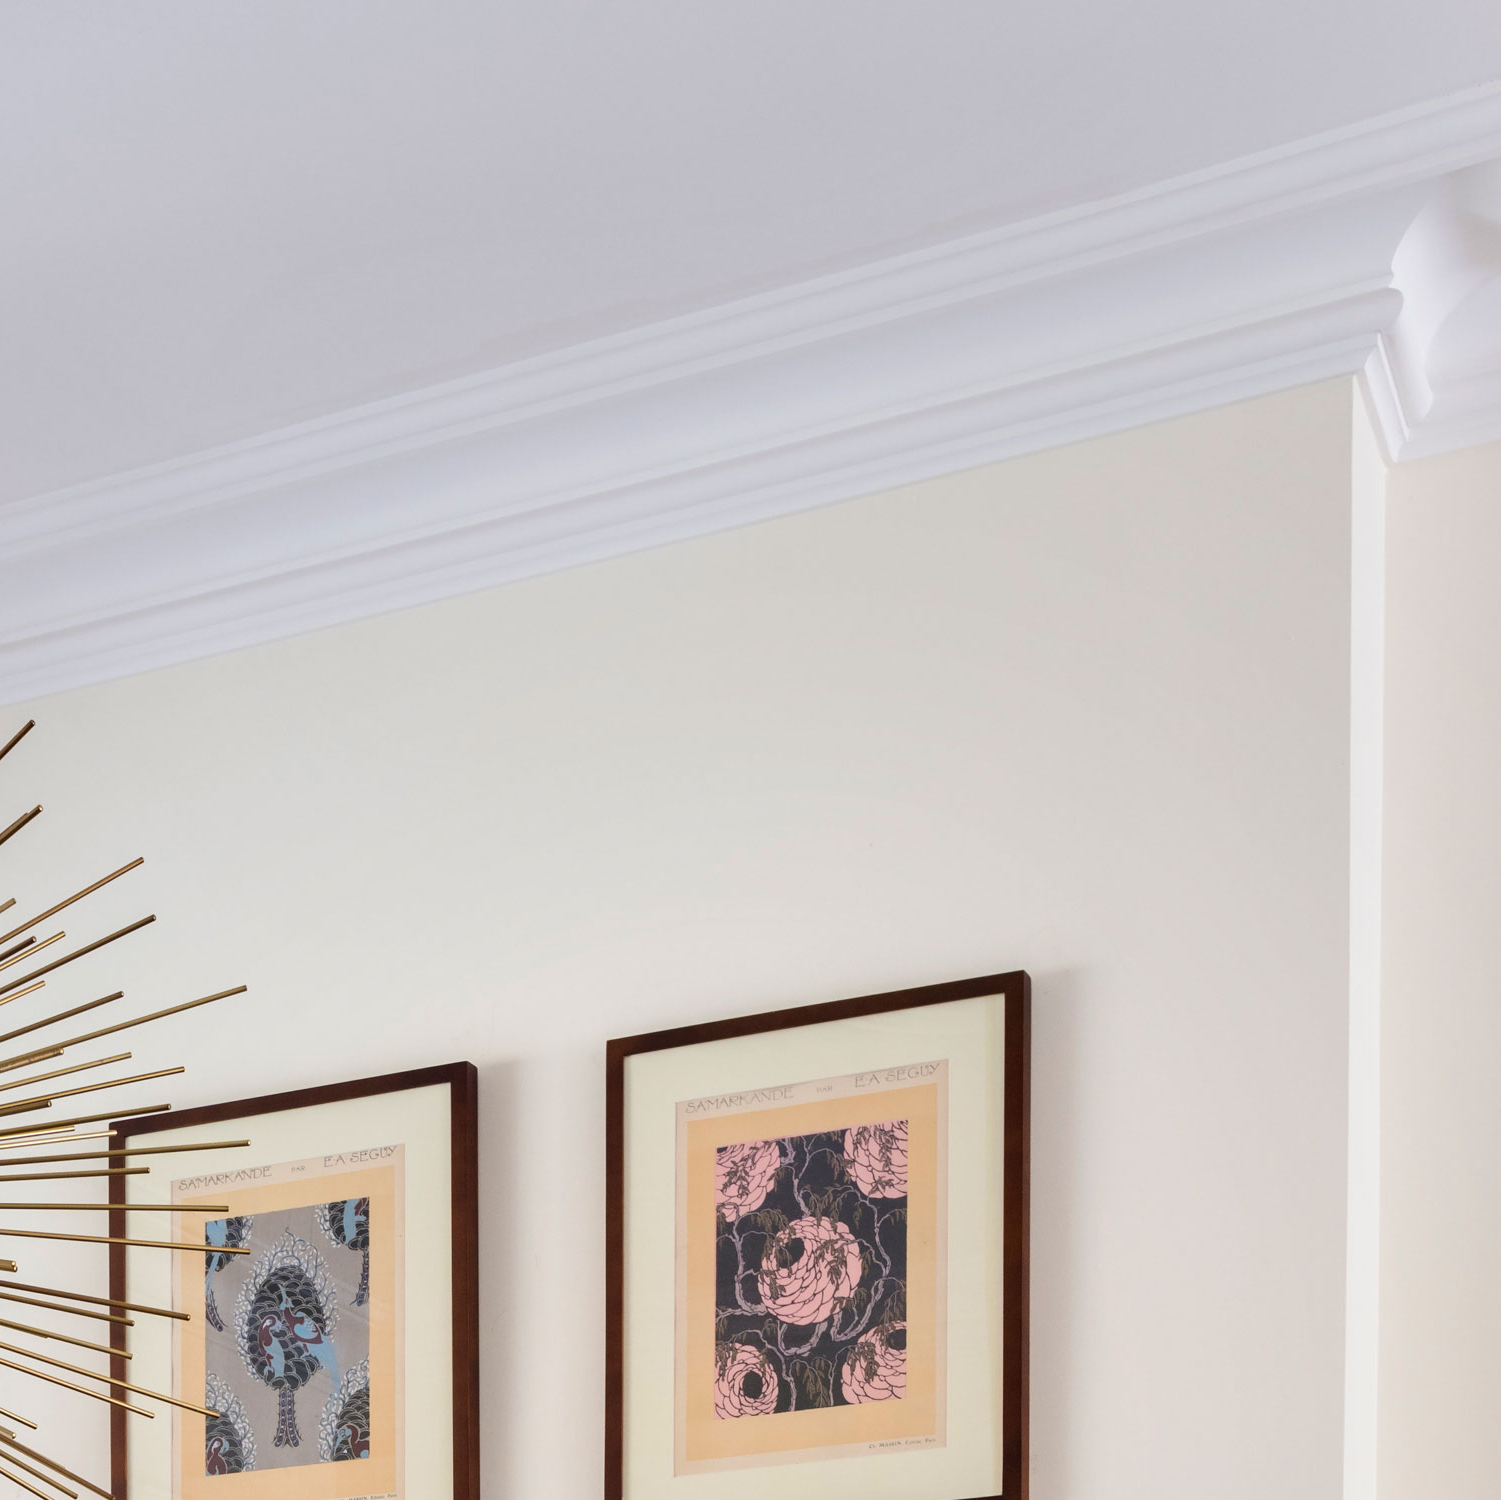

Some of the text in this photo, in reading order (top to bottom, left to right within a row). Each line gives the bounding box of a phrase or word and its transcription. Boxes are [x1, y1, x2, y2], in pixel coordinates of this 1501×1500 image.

[685, 1087, 795, 1114] SAMARKANDE
[178, 1166, 272, 1191] SAMARKANDE
[350, 1145, 397, 1163] SEGUY
